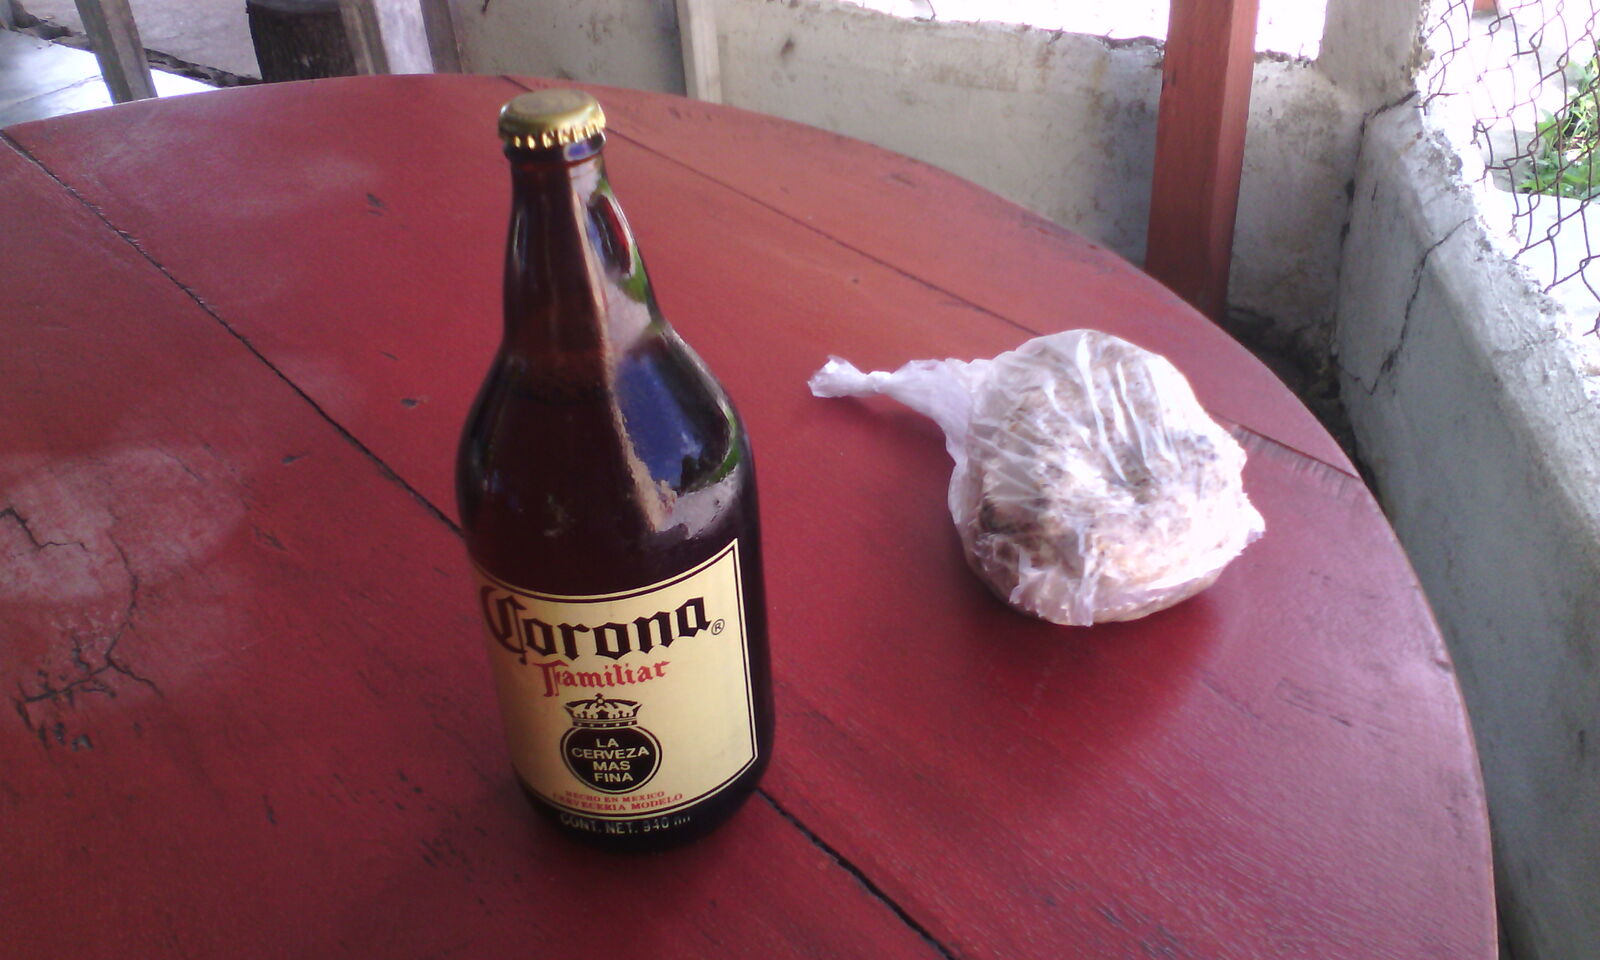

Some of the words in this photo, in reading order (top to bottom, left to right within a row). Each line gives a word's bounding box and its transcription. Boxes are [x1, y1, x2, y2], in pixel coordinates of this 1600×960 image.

[481, 586, 711, 664] Corona
[533, 660, 670, 697] Familiar
[596, 738, 619, 748] LA
[571, 746, 650, 760] CERVEZA
[593, 760, 631, 771] MAS
[594, 773, 634, 782] FINA
[622, 791, 665, 803] MEXICO
[631, 793, 683, 810] MODELO
